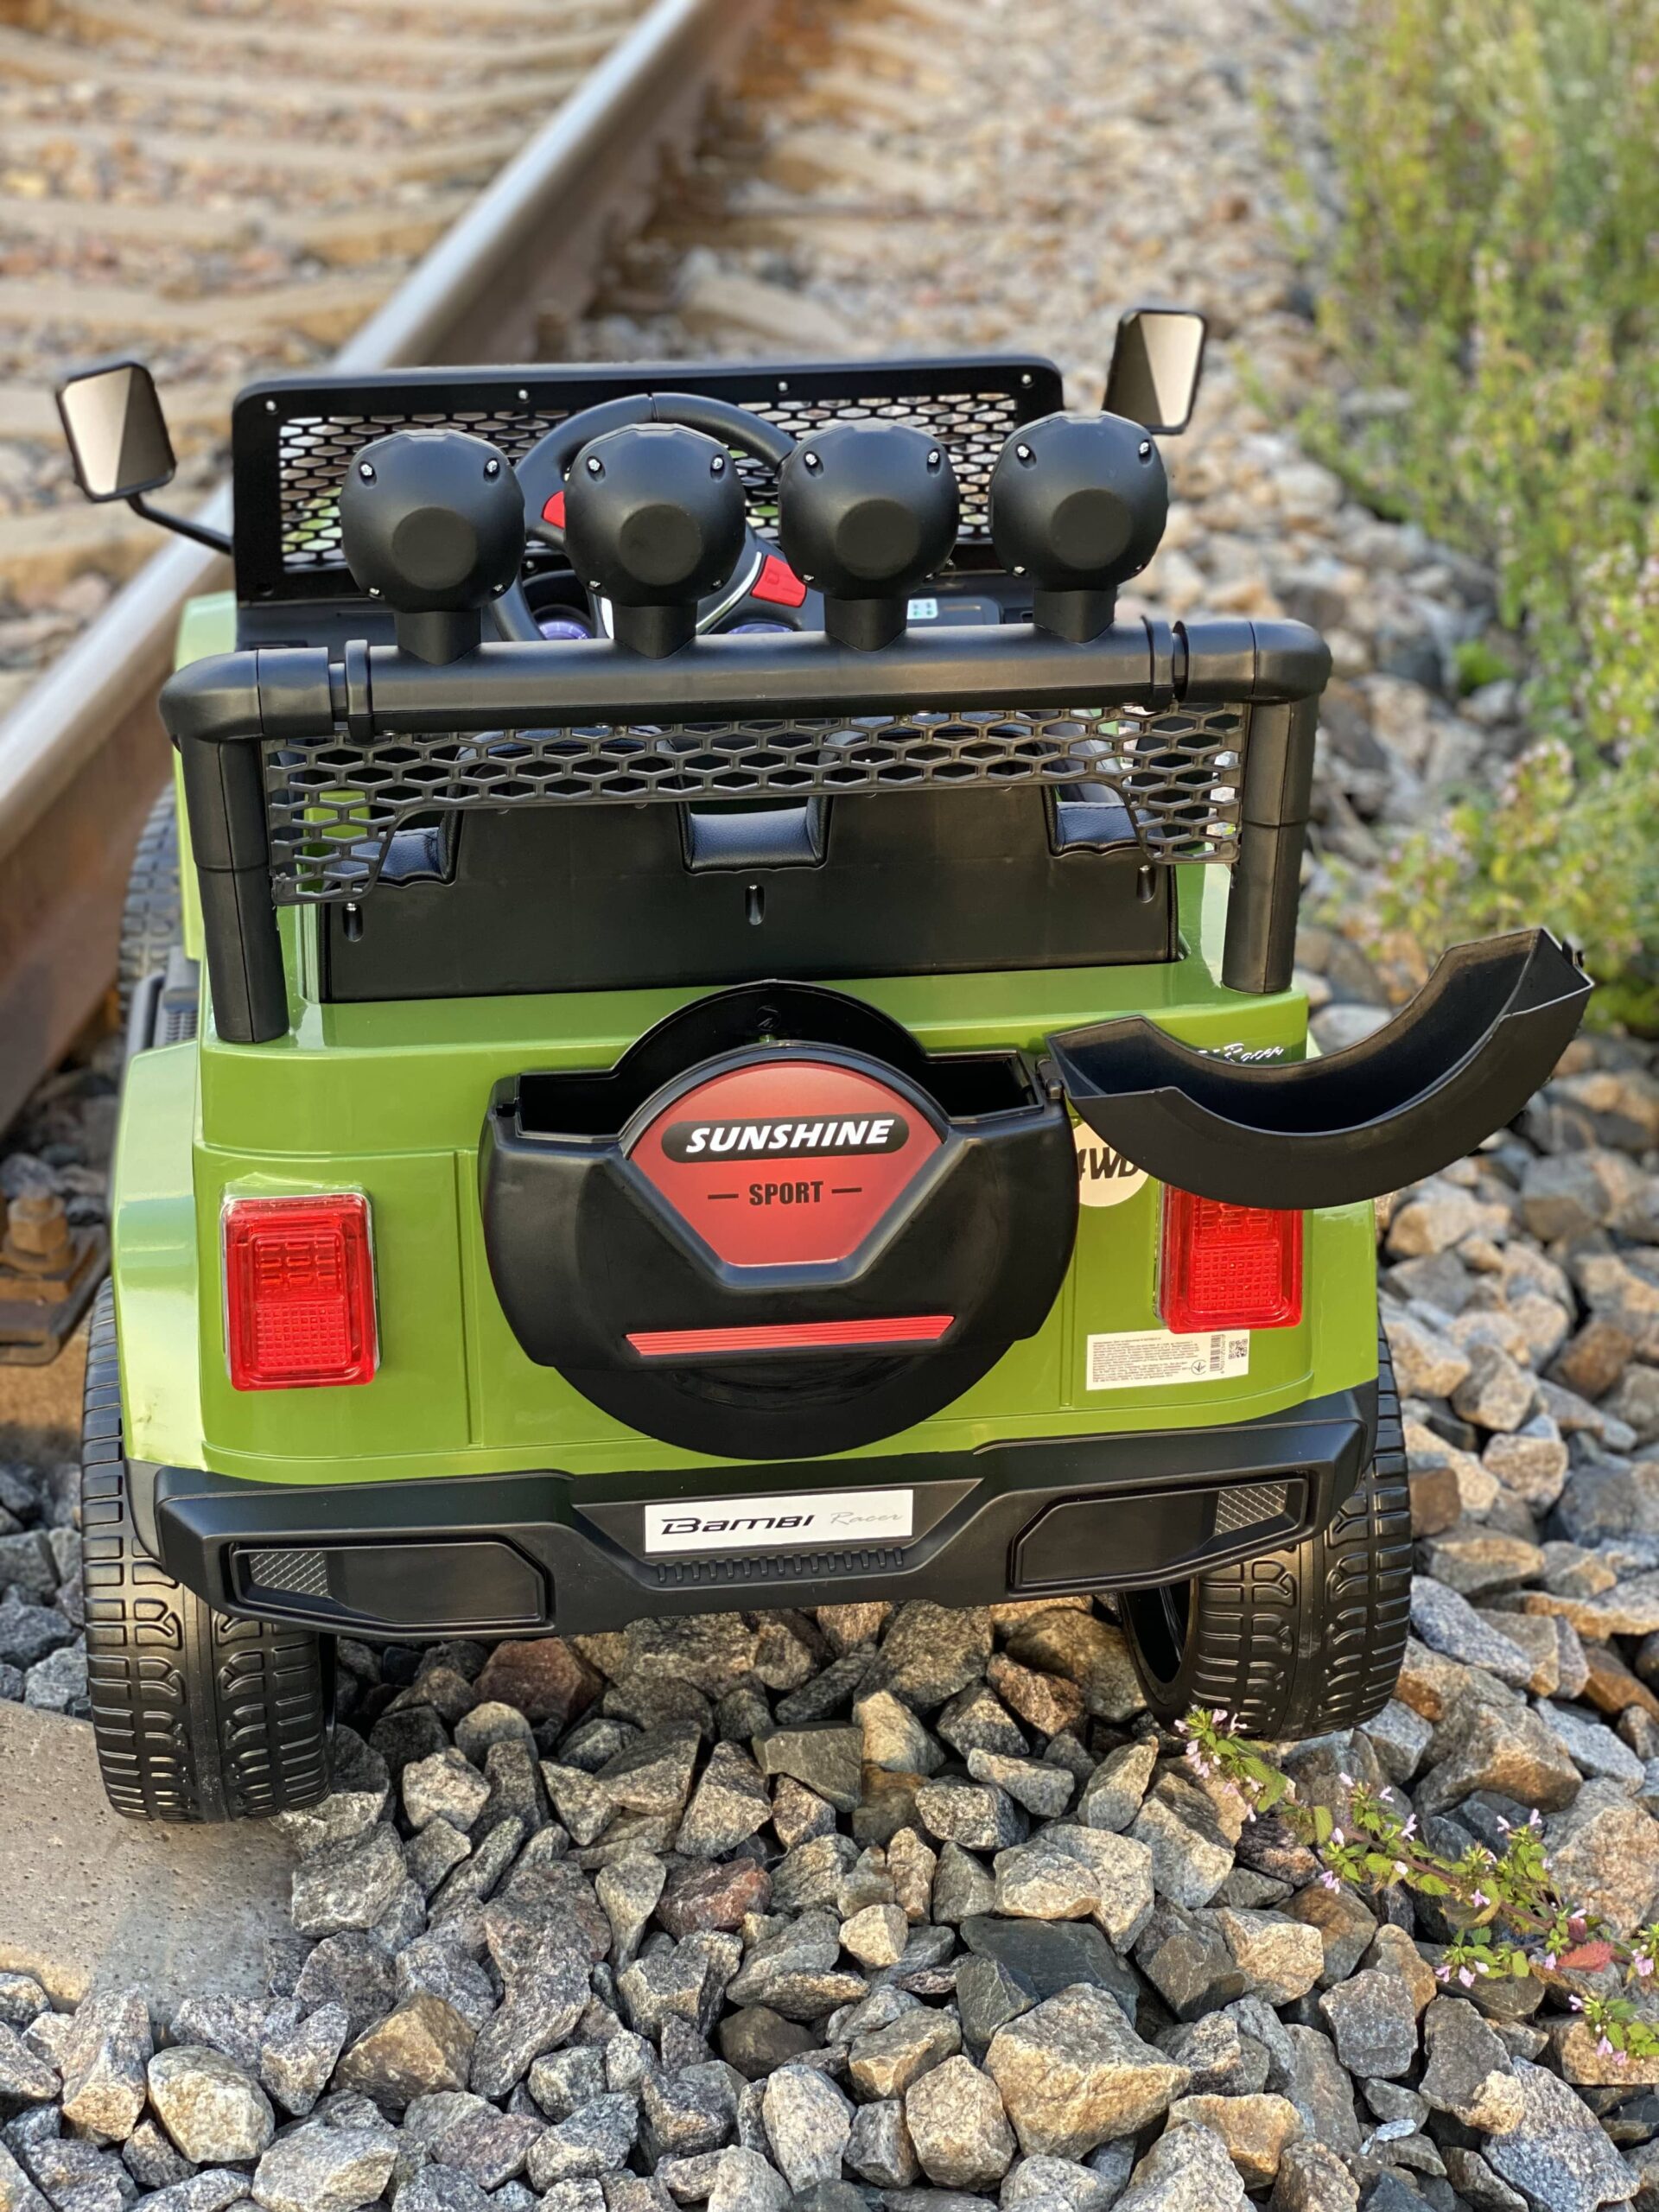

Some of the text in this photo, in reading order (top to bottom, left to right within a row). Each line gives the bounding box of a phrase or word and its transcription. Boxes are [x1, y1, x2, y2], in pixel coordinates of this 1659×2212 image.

[685, 1118, 895, 1154] SUNSHINE
[749, 1180, 824, 1206] SPORT
[830, 1511, 904, 1526] Racer
